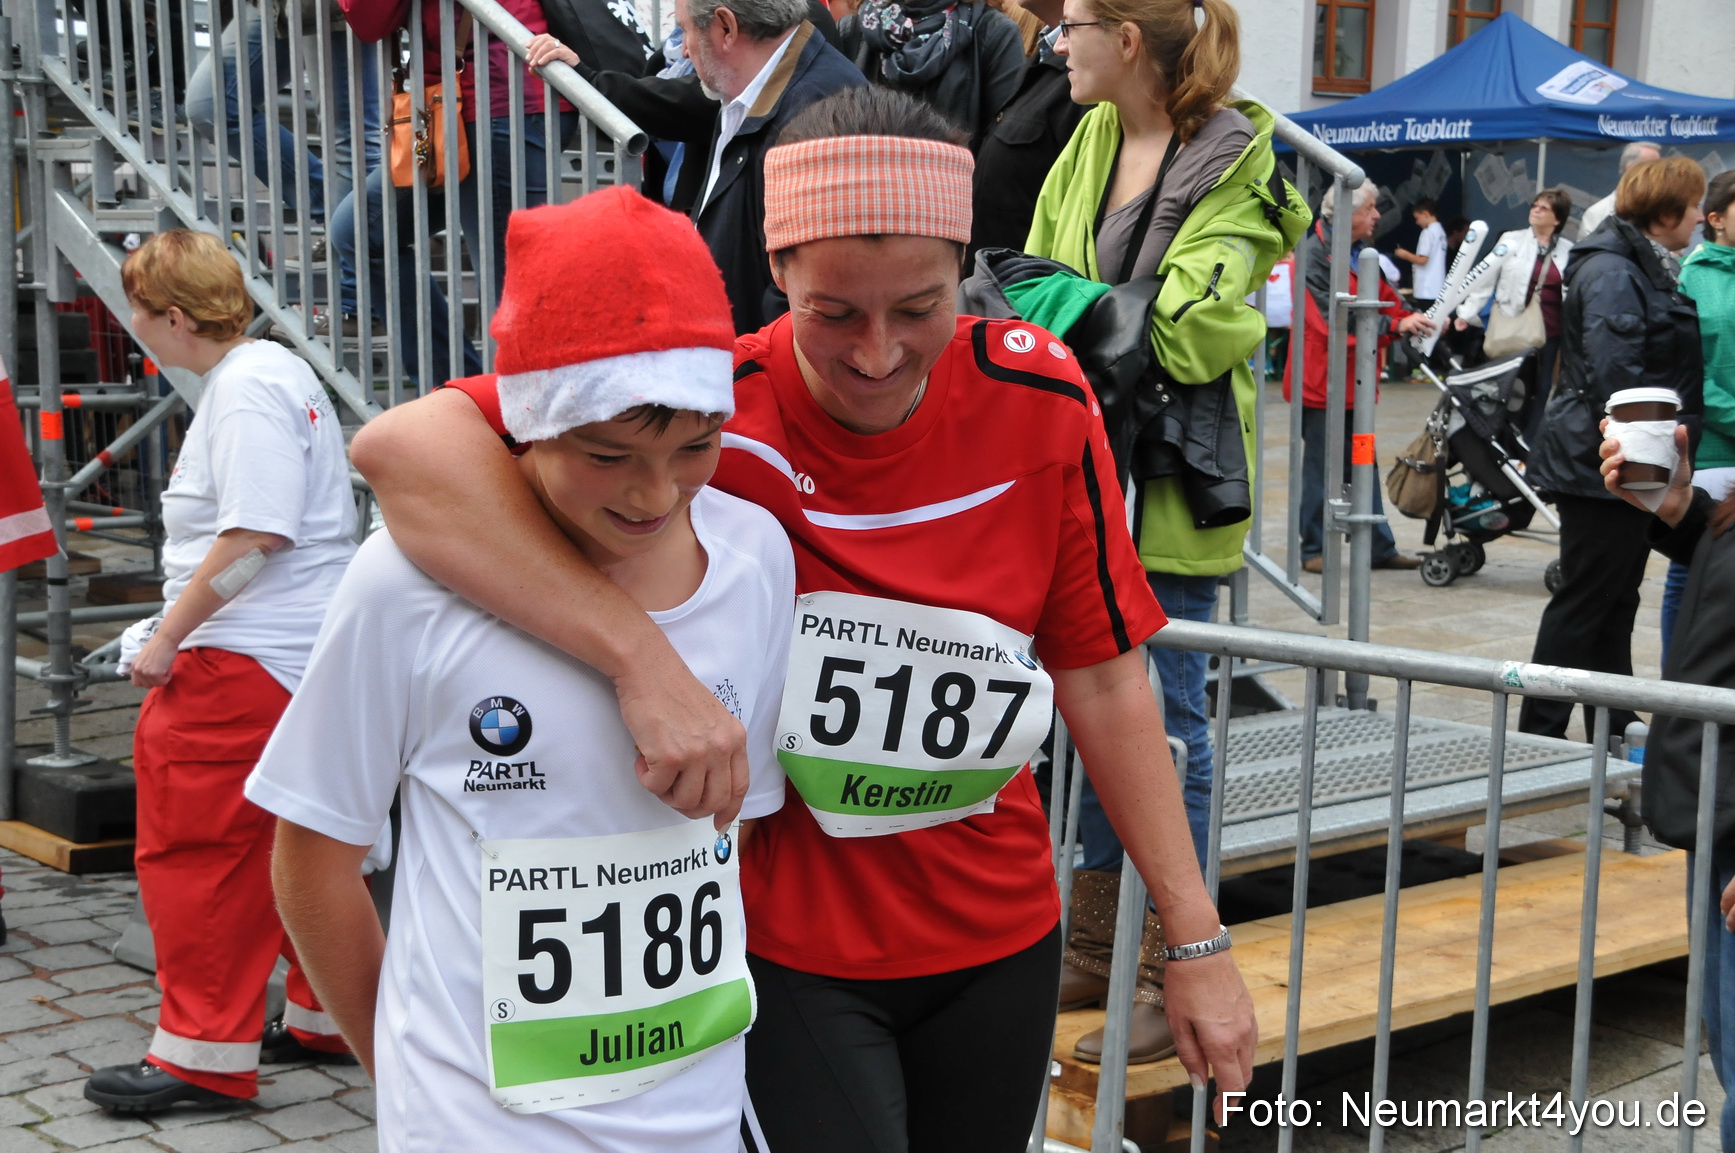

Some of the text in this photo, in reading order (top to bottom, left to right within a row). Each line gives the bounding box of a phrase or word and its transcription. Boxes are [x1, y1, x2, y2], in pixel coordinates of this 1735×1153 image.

[1313, 118, 1472, 144] Neumarkter Tagblatt
[1598, 114, 1719, 139] Neumarkter Tagblatt
[801, 614, 1014, 665] PARTL Neumarkt
[473, 698, 526, 719] BMW
[809, 655, 1032, 760] 5187
[464, 778, 546, 792] Neumarkt
[466, 760, 545, 780] PARTL
[840, 773, 953, 808] Kerstin
[489, 847, 708, 892] PARTL Neumarkt
[517, 880, 723, 1005] 5186
[579, 1020, 685, 1066] Julian
